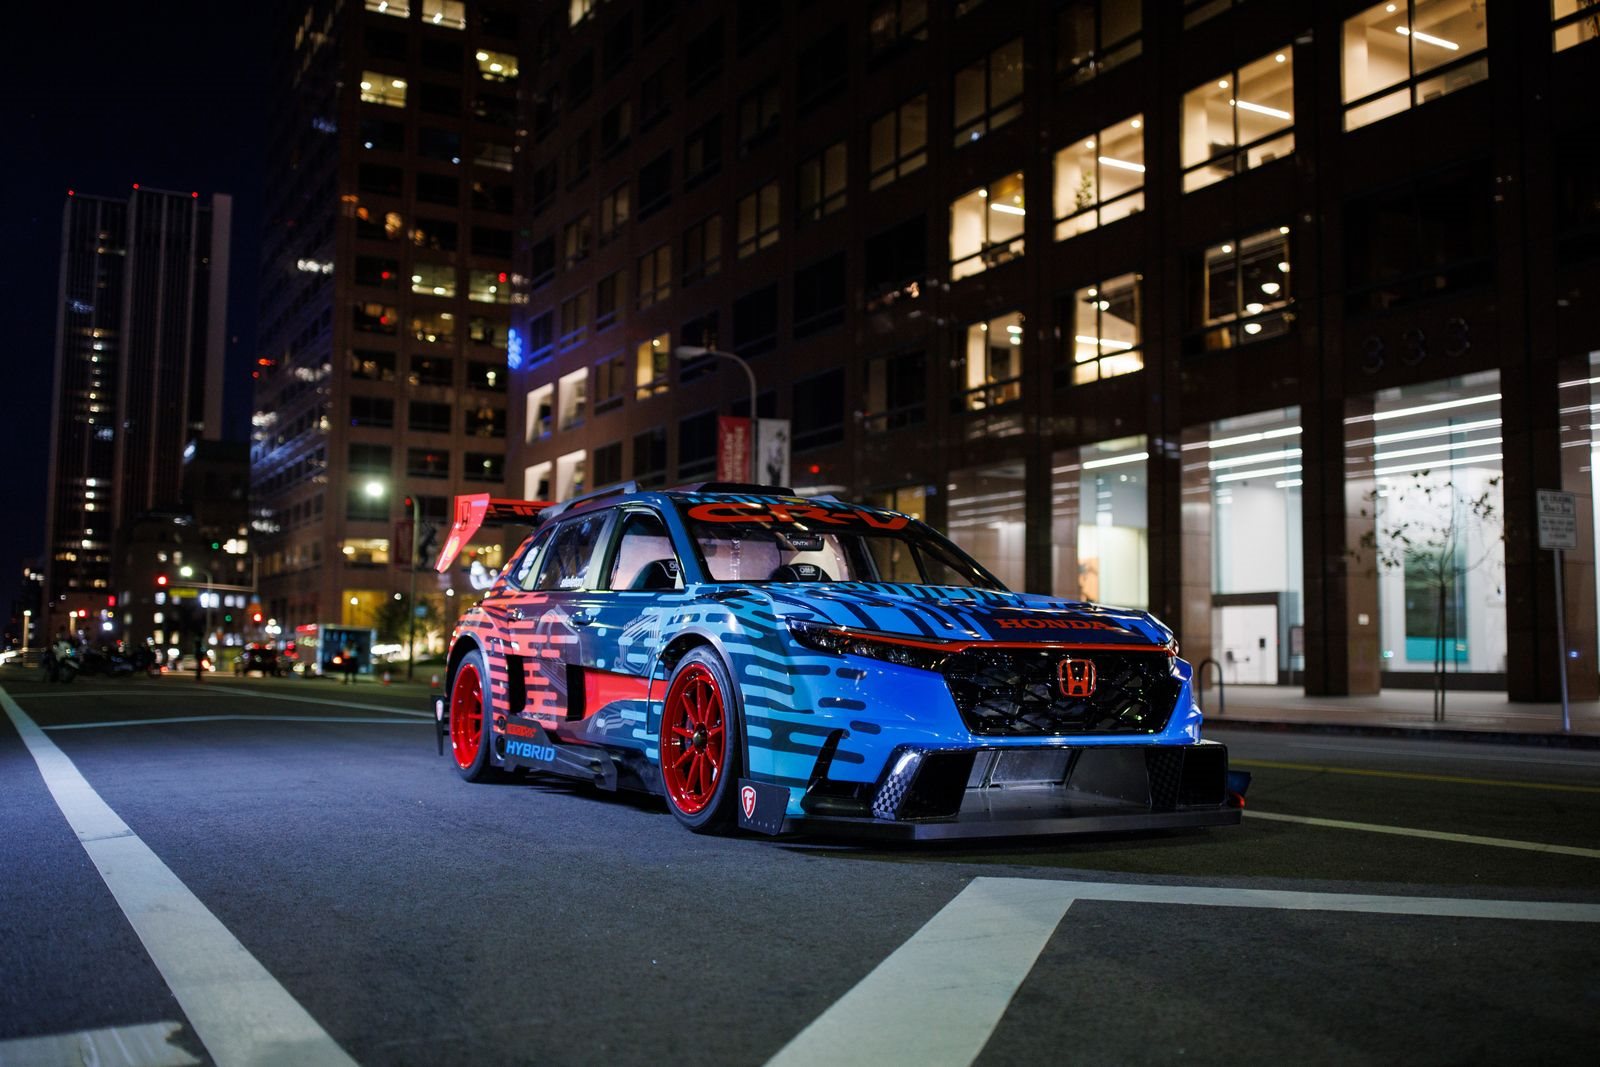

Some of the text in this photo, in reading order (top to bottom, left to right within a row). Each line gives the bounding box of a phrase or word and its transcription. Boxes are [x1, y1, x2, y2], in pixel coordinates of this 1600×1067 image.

[687, 502, 910, 531] CR-V
[993, 618, 1118, 631] HONDA
[505, 740, 556, 762] HYBRID
